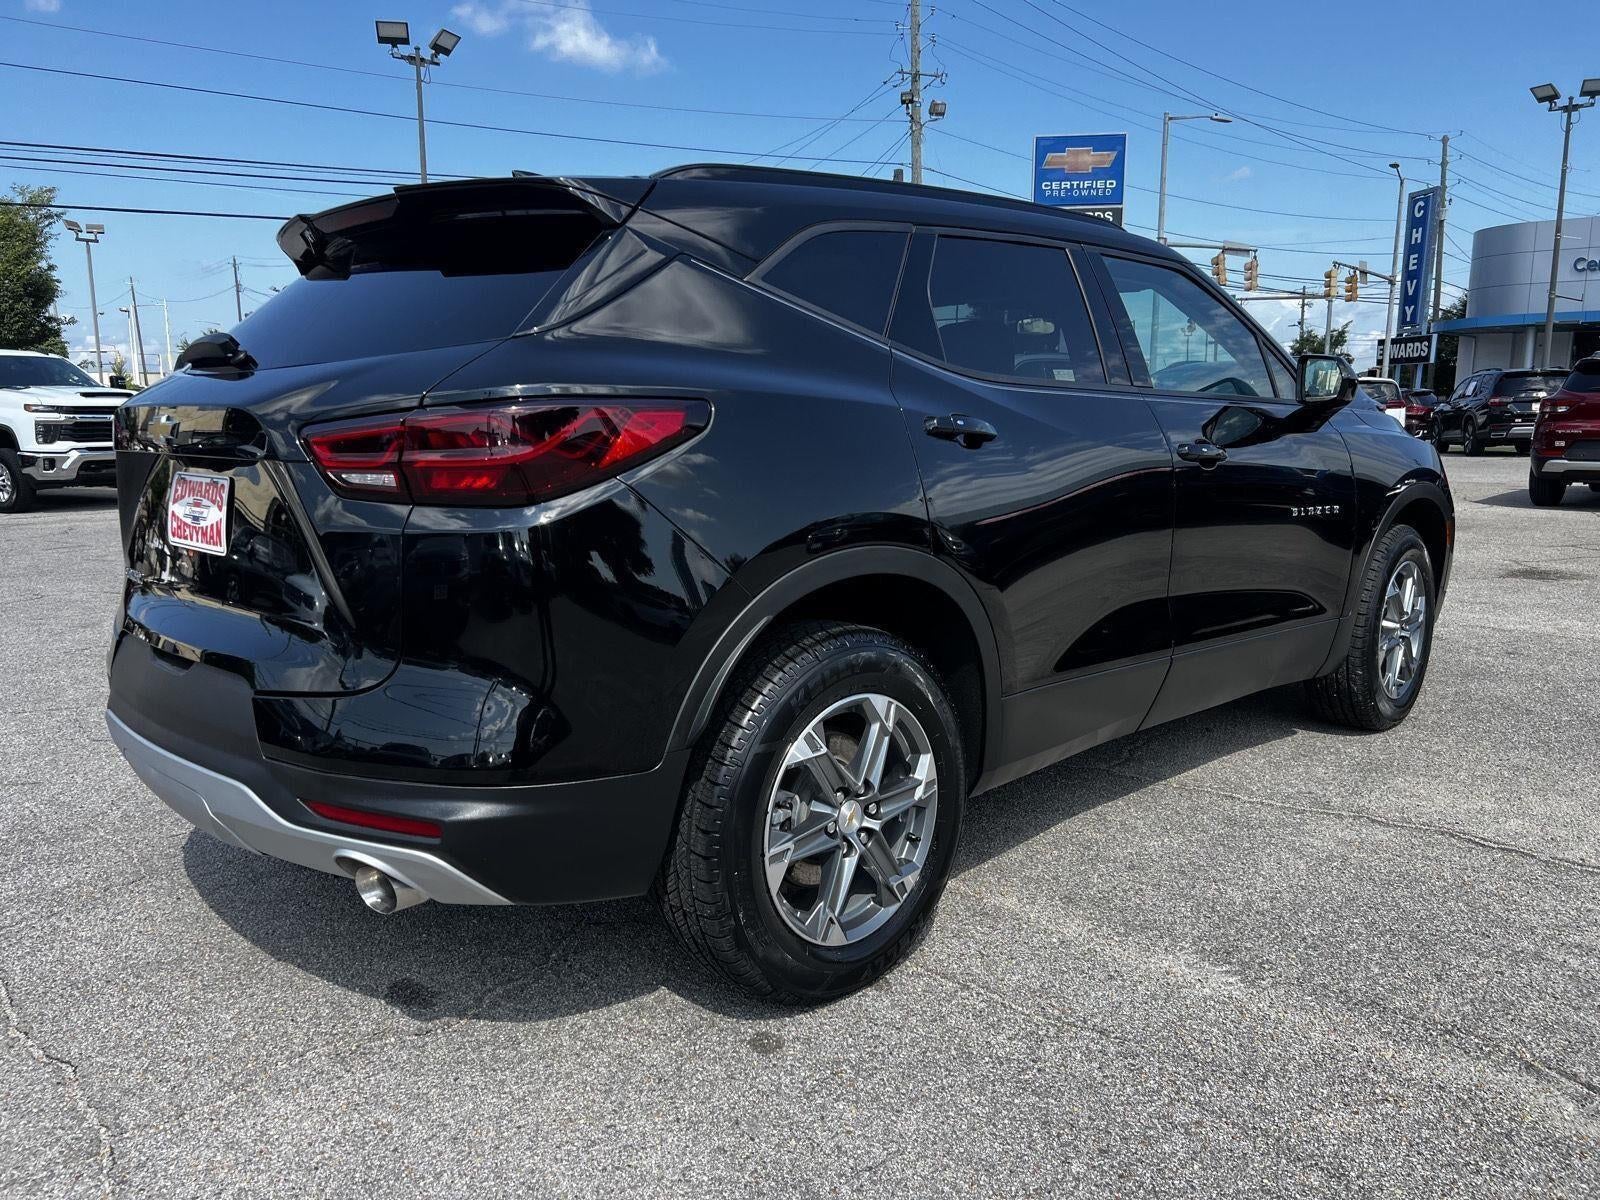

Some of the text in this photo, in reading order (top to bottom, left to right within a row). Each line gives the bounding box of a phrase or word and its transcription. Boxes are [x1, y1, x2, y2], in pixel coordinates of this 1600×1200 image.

[1041, 180, 1117, 190] CERTIFIED
[1045, 189, 1112, 197] PRE-OWNED
[1404, 201, 1425, 322] CHEVY
[1377, 341, 1429, 360] EWARDS
[173, 479, 225, 512] EDWARDS
[1291, 505, 1339, 516] BLAZER
[171, 510, 222, 547] CHEVYMAN
